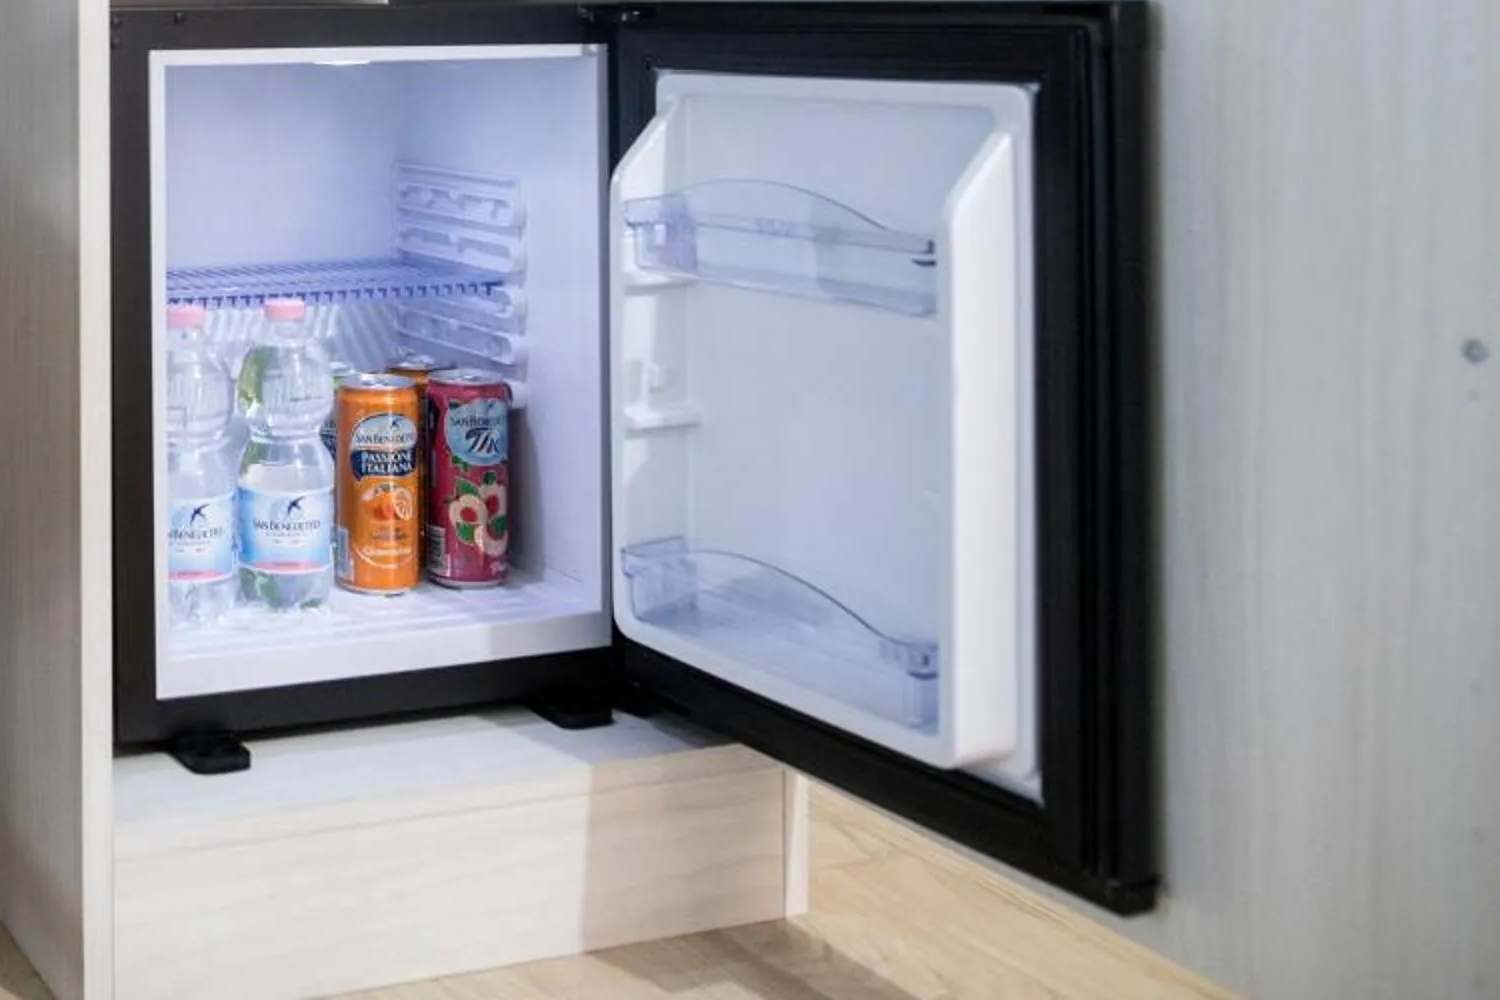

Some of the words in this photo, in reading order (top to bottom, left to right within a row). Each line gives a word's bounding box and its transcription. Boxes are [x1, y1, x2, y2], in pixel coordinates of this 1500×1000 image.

[361, 451, 411, 463] PASSIONE
[361, 463, 412, 474] ITALIANA
[253, 518, 269, 530] SAN
[270, 519, 321, 532] BENEDETTO
